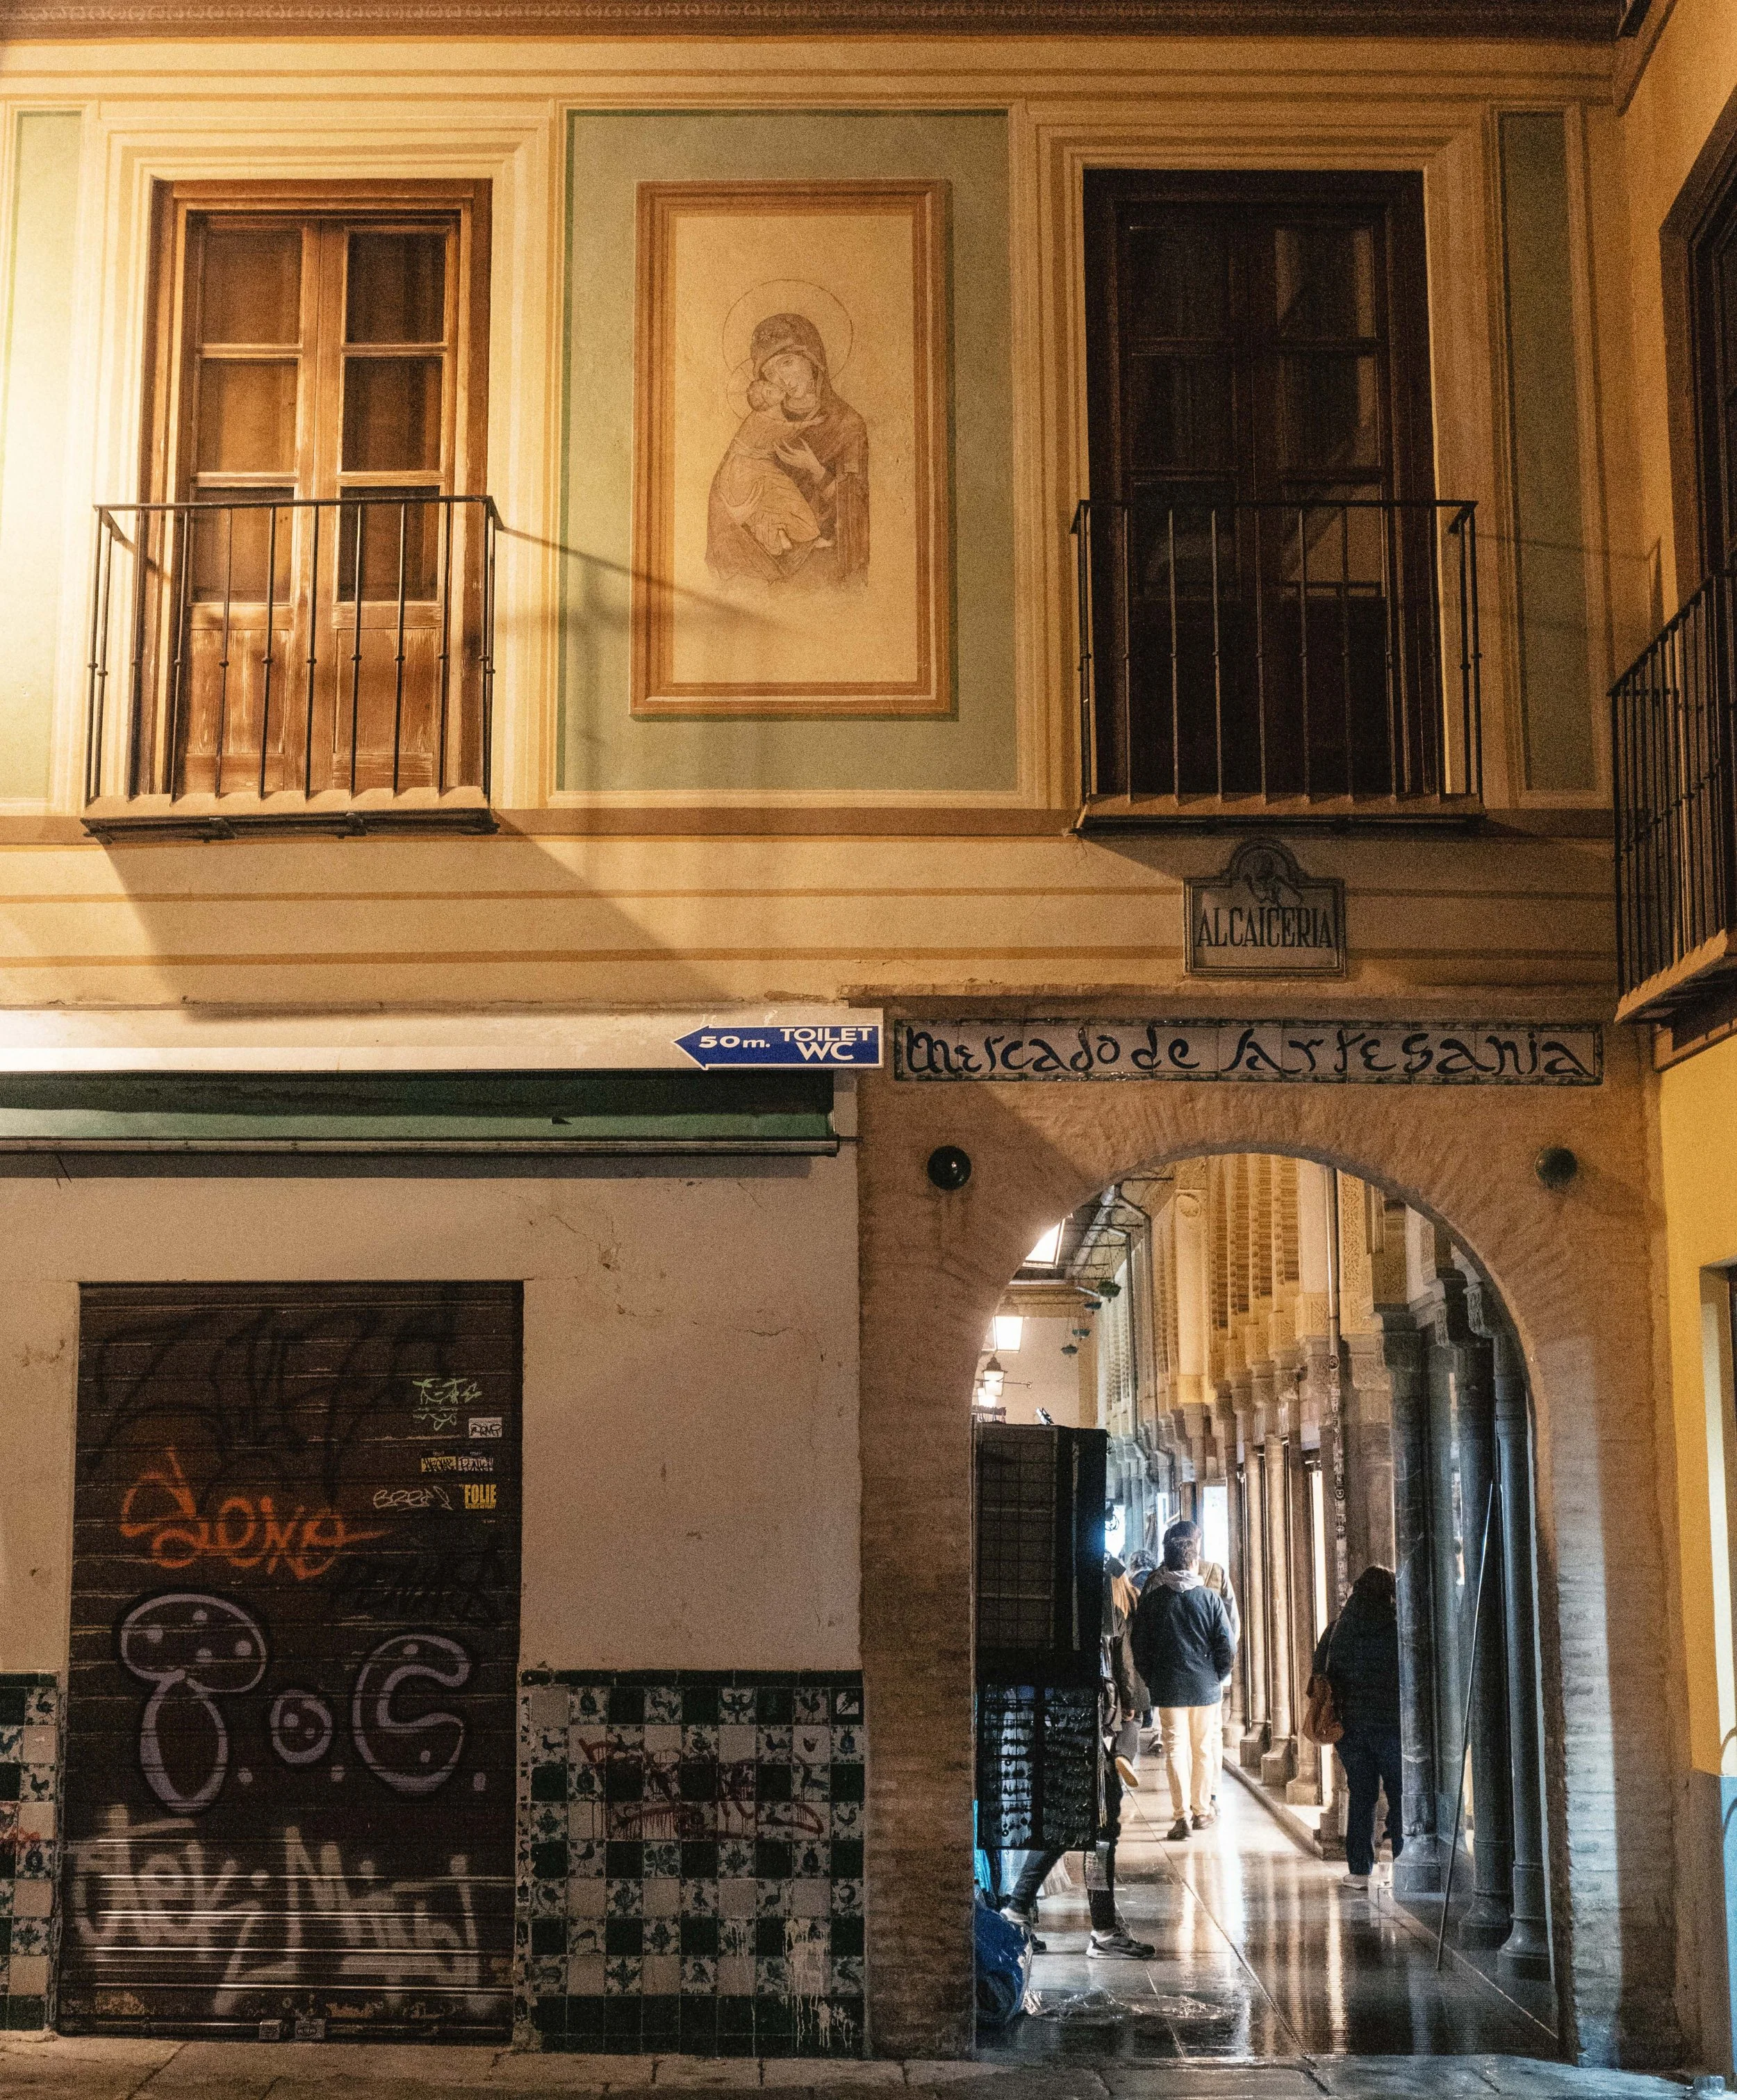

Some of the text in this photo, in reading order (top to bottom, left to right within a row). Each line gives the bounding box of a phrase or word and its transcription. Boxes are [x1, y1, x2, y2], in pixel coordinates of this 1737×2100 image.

[1195, 905, 1333, 948] ALCAICERIA
[780, 1027, 873, 1042] TOILET
[795, 1041, 855, 1061] WC
[1130, 1024, 1200, 1071] de
[464, 1483, 497, 1504] FOLIE
